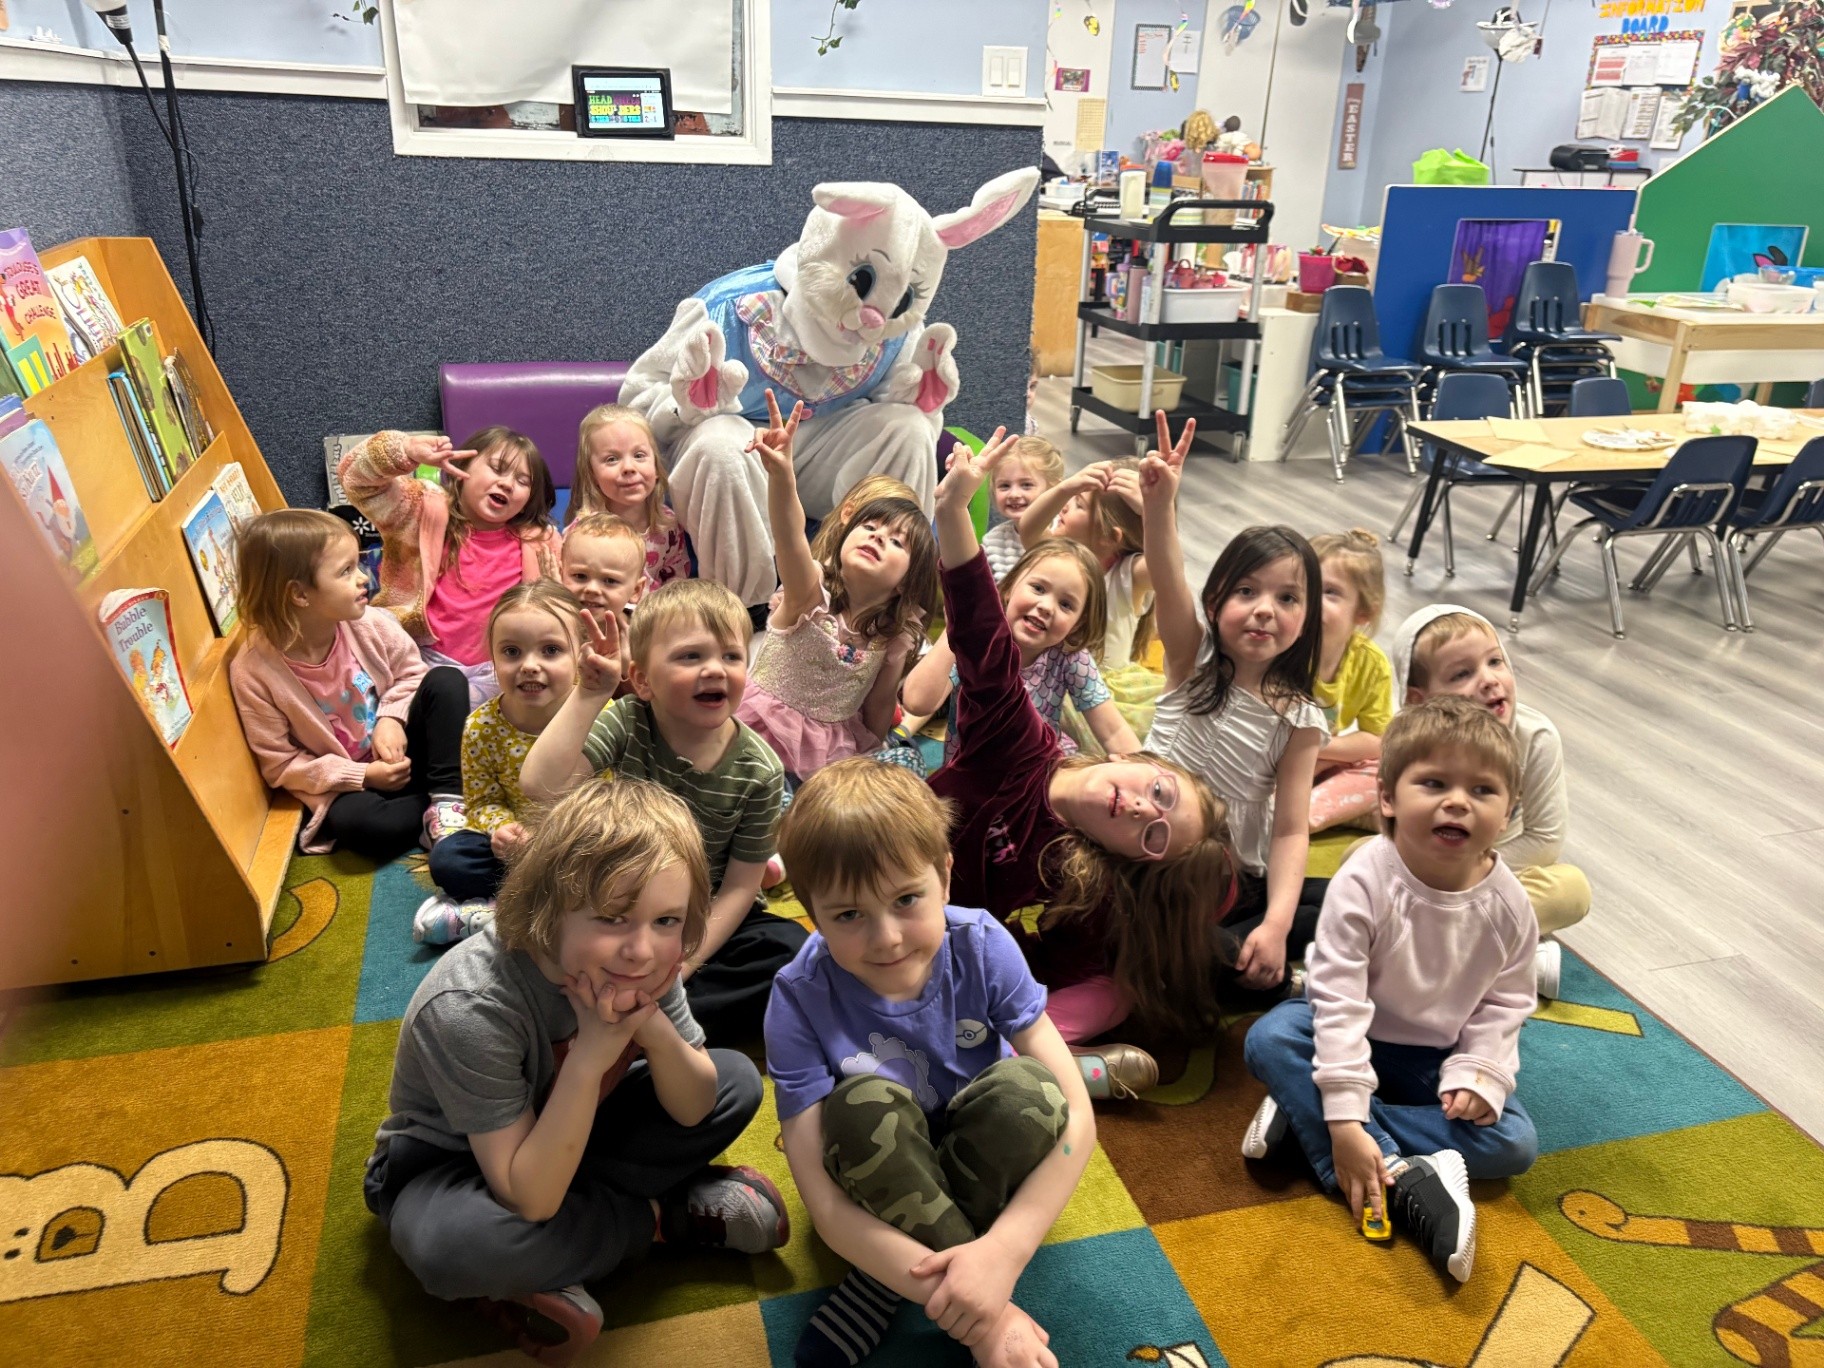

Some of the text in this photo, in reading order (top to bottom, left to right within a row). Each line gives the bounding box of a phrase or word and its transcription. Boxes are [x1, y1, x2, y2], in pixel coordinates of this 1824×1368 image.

[1599, 0, 1705, 18] INFORMATION
[1621, 15, 1669, 34] BOARD
[589, 94, 613, 105] HEAD
[1342, 104, 1360, 162] EASTER
[114, 606, 147, 636] Bubble
[117, 621, 154, 653] Trouble
